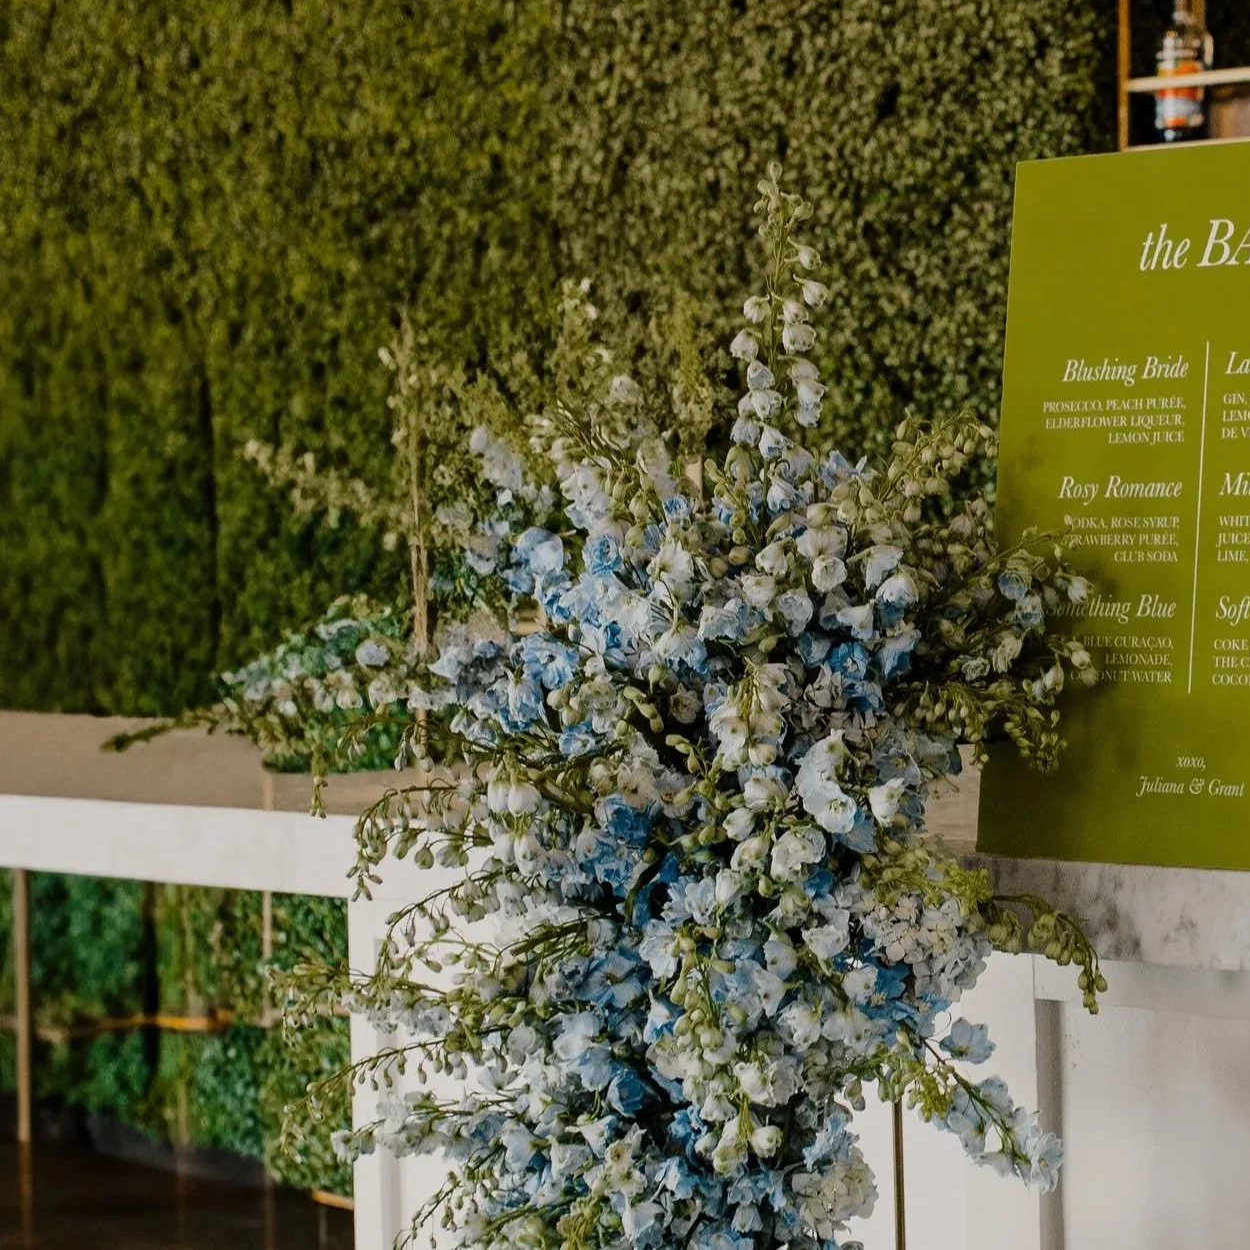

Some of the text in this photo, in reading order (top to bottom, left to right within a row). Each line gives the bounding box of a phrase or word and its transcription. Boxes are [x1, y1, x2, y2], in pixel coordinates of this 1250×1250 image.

[1139, 222, 1191, 271] the
[1062, 354, 1189, 387] Blushing Bride
[1043, 395, 1187, 413] PROSECCO, PEACH PURÉE,
[1223, 392, 1248, 406] GIN,
[1045, 413, 1185, 429] ELDERFLOWER LIQUEUR,
[1108, 430, 1185, 446] LEMON JUICE
[1221, 426, 1238, 439] DE
[1058, 475, 1183, 506] Rosy Romance
[1066, 516, 1180, 531] ODKA, ROSE SYRUP,
[1114, 551, 1178, 563] CLUB SODA
[1216, 550, 1249, 563] LIME,
[1136, 593, 1177, 618] Blue
[1215, 595, 1250, 626] Soft
[1083, 636, 1113, 648] BLUE
[1213, 638, 1249, 651] COKE
[1105, 653, 1173, 667] LEMONADE,
[1212, 656, 1238, 668] THE
[1131, 670, 1172, 683] WATER
[1176, 756, 1206, 771] xoxo,
[1135, 775, 1245, 798] Juliana & Grant
